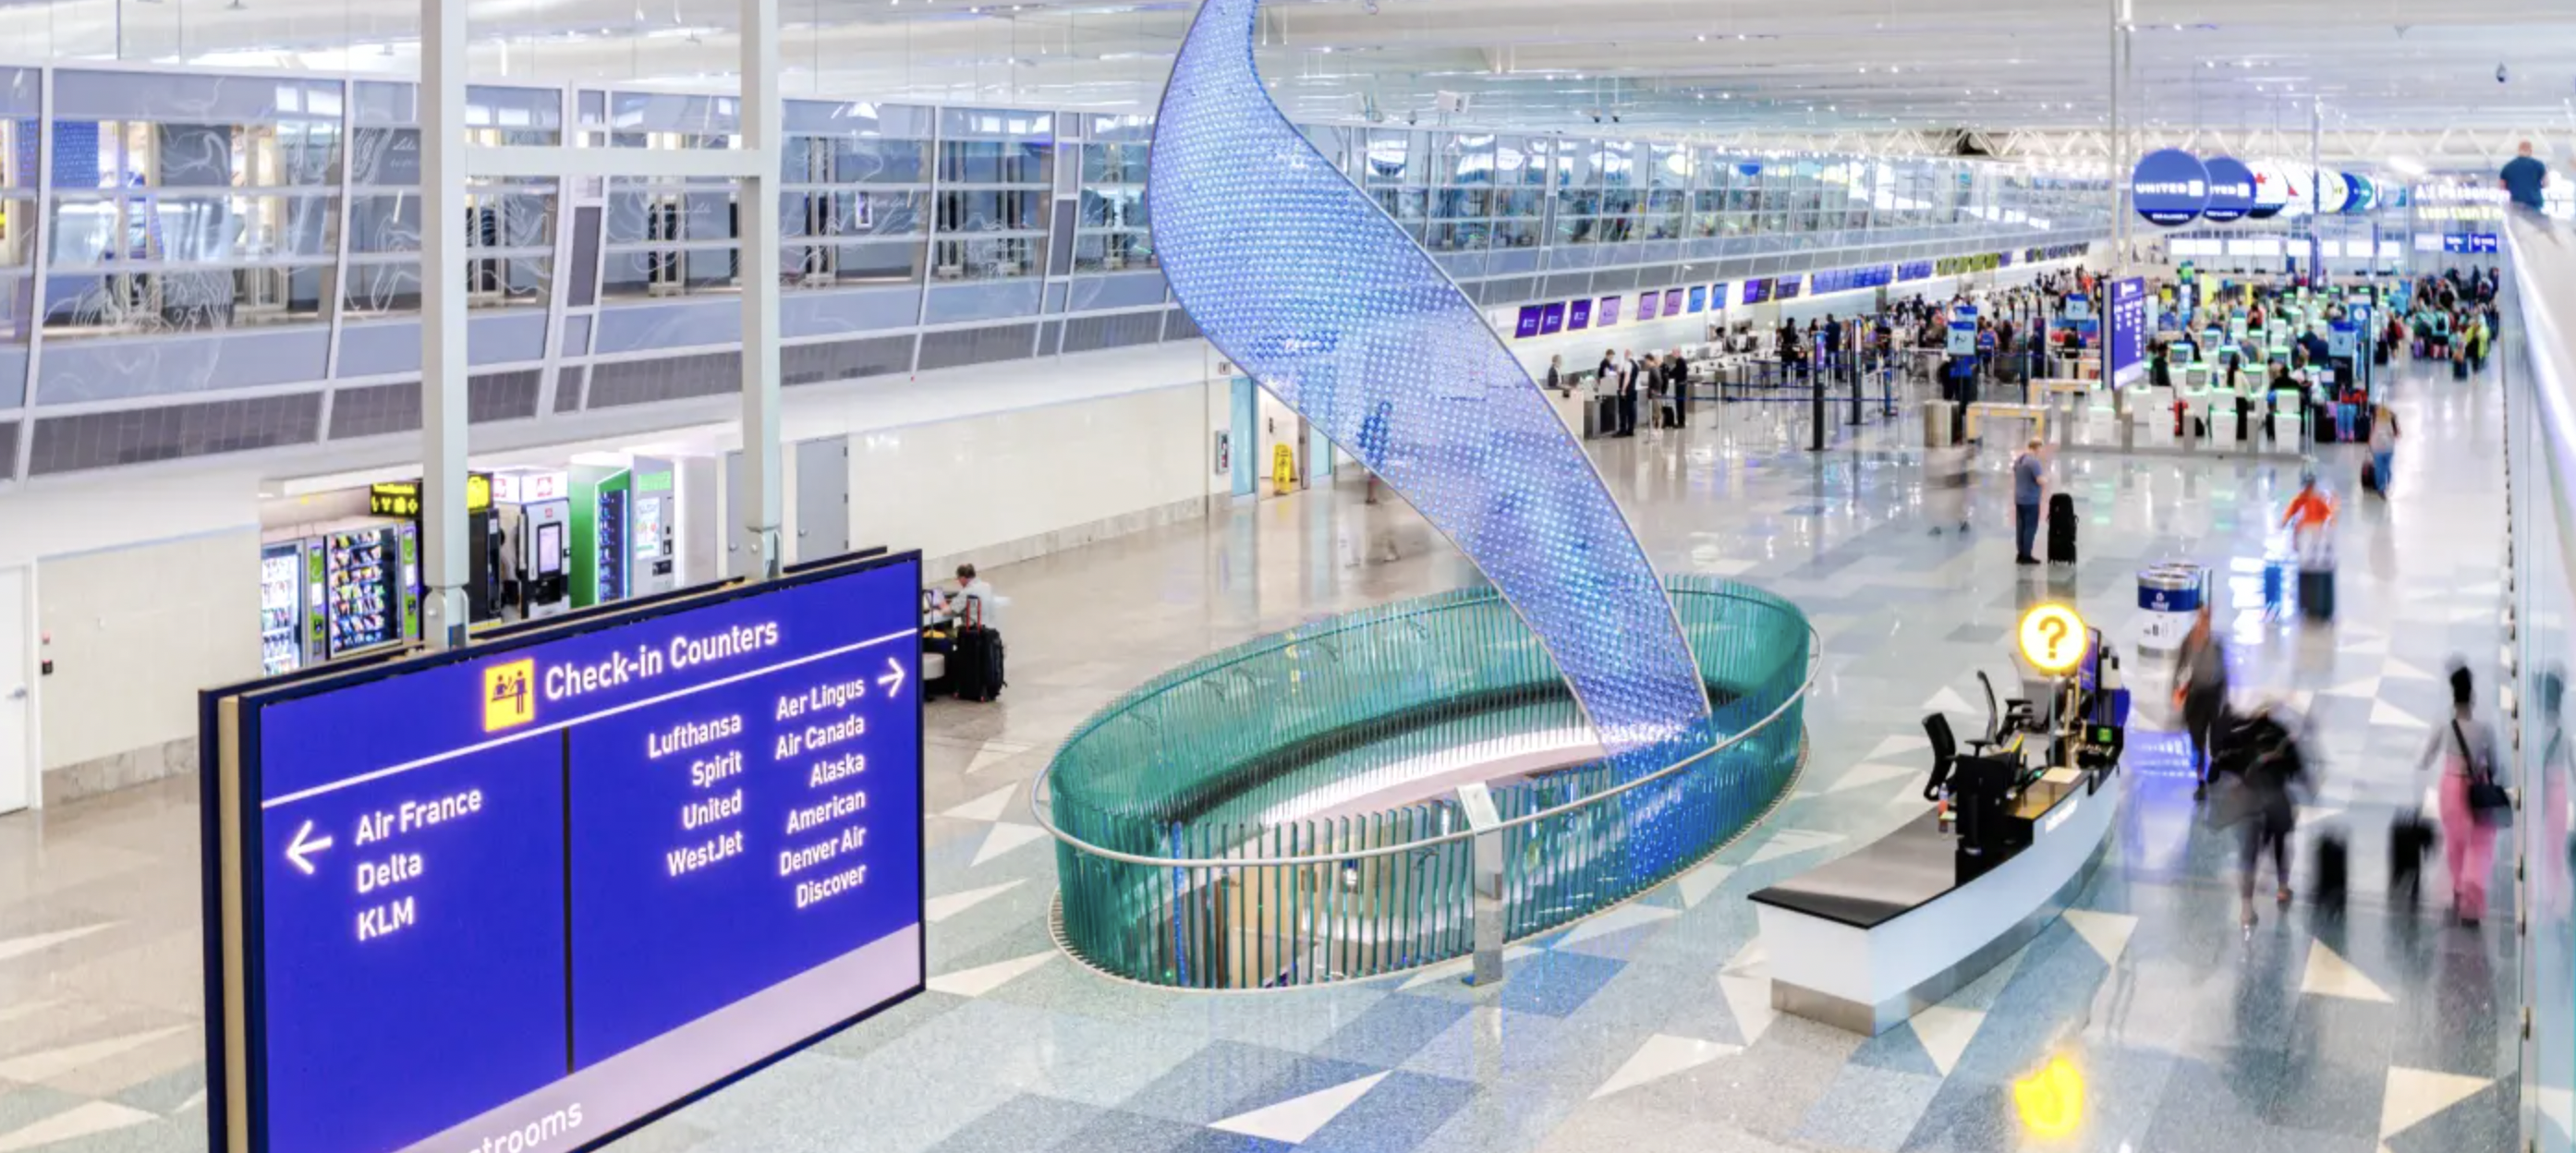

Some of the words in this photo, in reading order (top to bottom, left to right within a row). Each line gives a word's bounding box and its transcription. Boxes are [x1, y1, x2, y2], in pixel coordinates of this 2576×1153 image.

[2135, 183, 2187, 194] UNITED
[2209, 185, 2237, 195] ITED
[545, 644, 663, 700] Check-in
[670, 622, 779, 669] Counters
[776, 695, 808, 721] Aer
[810, 679, 865, 710] Lingus
[649, 714, 742, 759] Lufthansa
[775, 733, 803, 760] Air
[805, 714, 865, 750] Canada
[691, 750, 742, 788] Spirit
[809, 753, 865, 788] Alaska
[355, 810, 395, 846] Air
[399, 789, 482, 832] France
[683, 788, 742, 830] United
[786, 791, 866, 834] American
[357, 853, 423, 893] Delta
[666, 831, 743, 877] WestJet
[780, 838, 839, 877] Denver
[840, 825, 867, 853] Air
[796, 864, 867, 908] Discover
[358, 895, 415, 941] KLM
[468, 1102, 584, 1153] trooms
